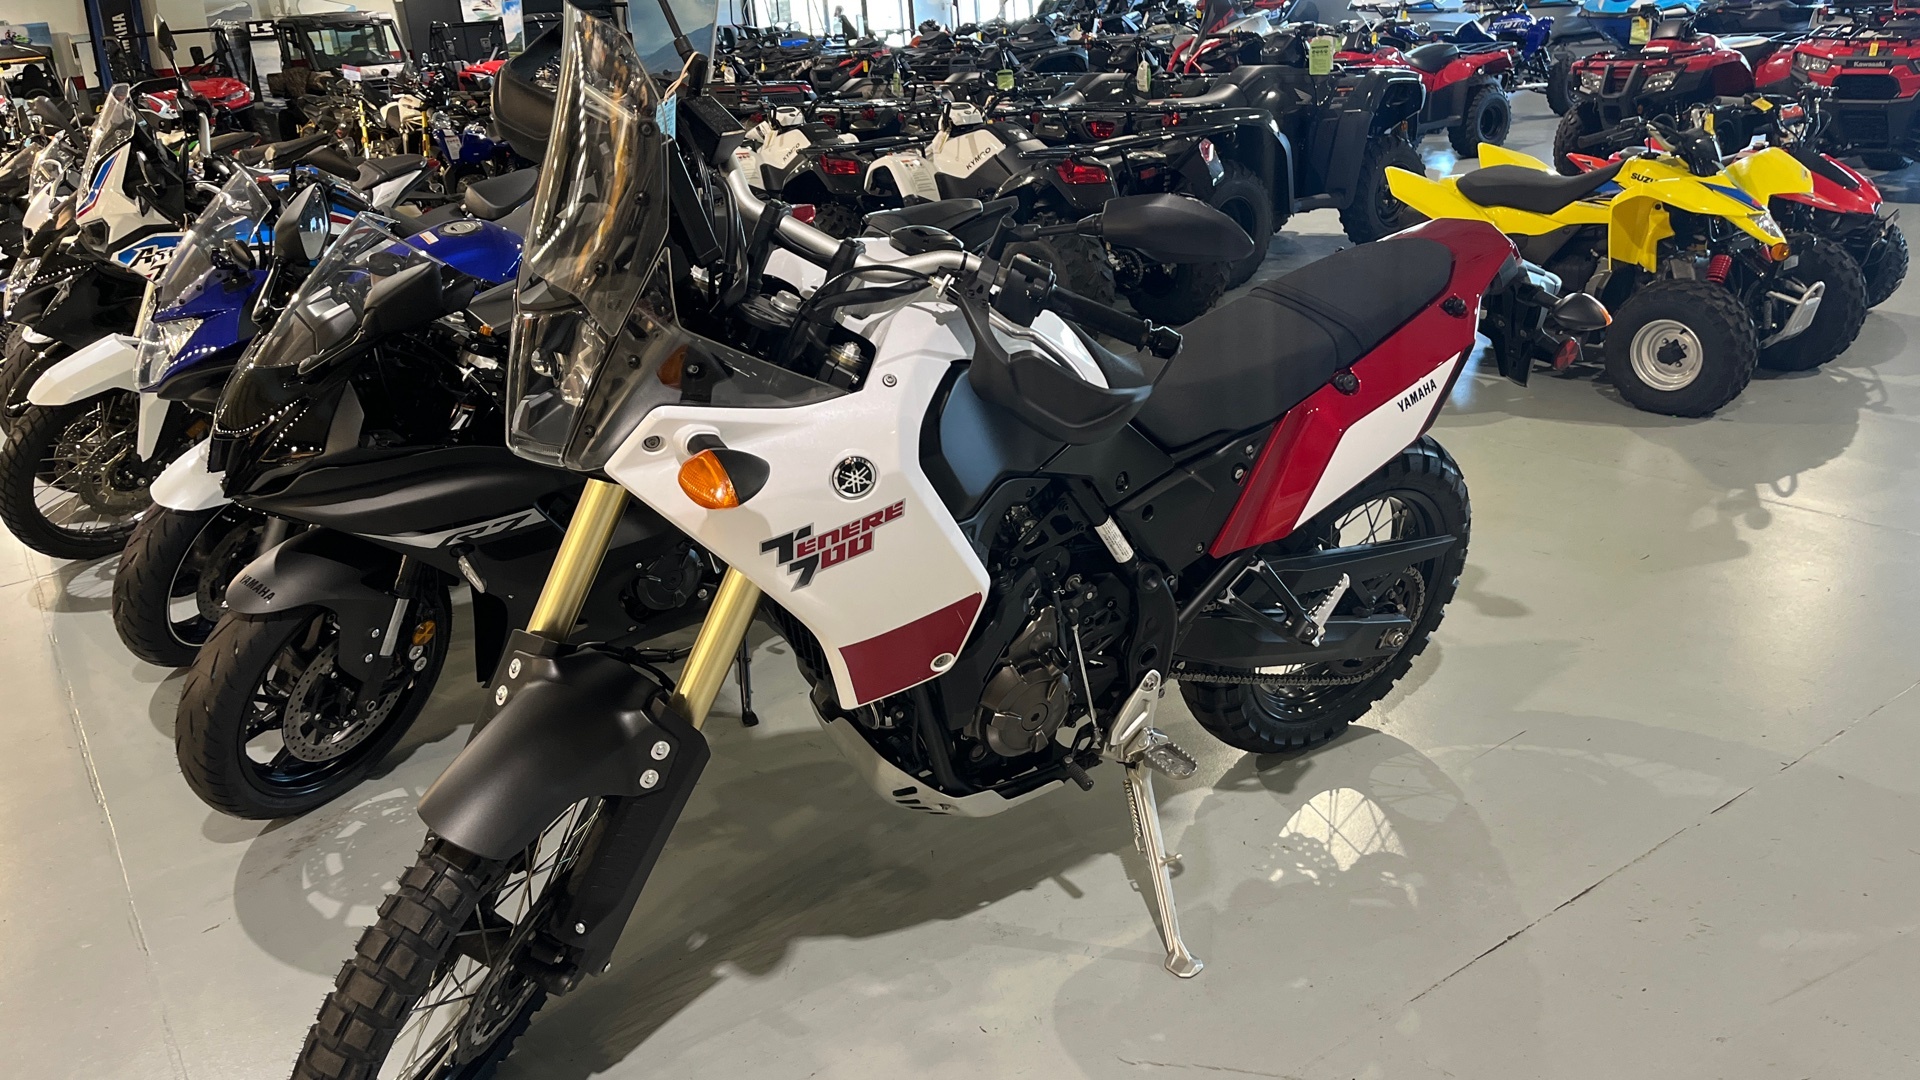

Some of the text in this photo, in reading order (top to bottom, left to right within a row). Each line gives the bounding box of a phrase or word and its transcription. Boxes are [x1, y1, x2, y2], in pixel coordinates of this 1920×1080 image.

[1396, 378, 1438, 413] YAMAHA
[786, 528, 876, 593] 700
[239, 573, 276, 601] YAMAHA
